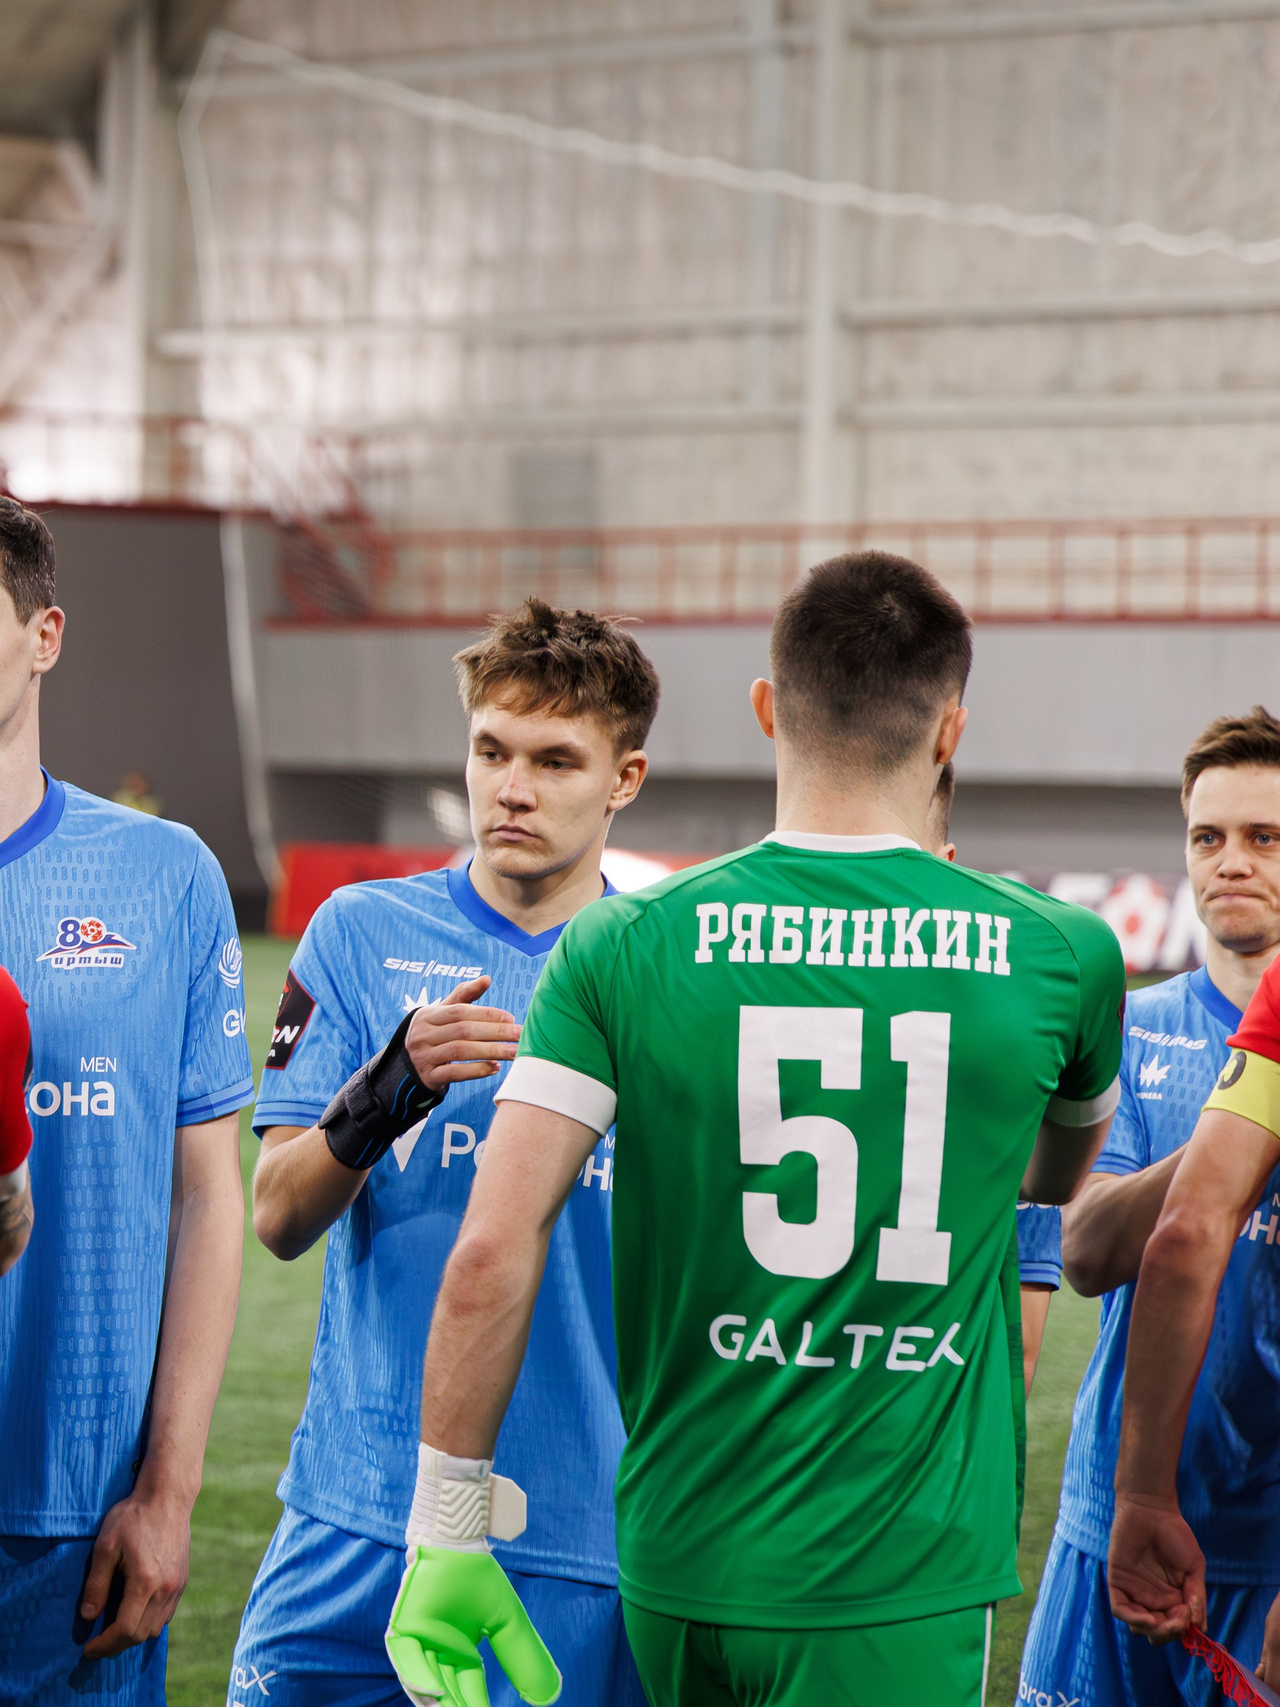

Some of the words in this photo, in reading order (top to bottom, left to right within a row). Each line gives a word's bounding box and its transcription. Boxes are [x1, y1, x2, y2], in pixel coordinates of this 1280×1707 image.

[695, 902, 1011, 976] РЯБИНКИН
[80, 1056, 117, 1073] MEN
[737, 1005, 952, 1286] 51
[708, 1314, 965, 1372] GALTEX
